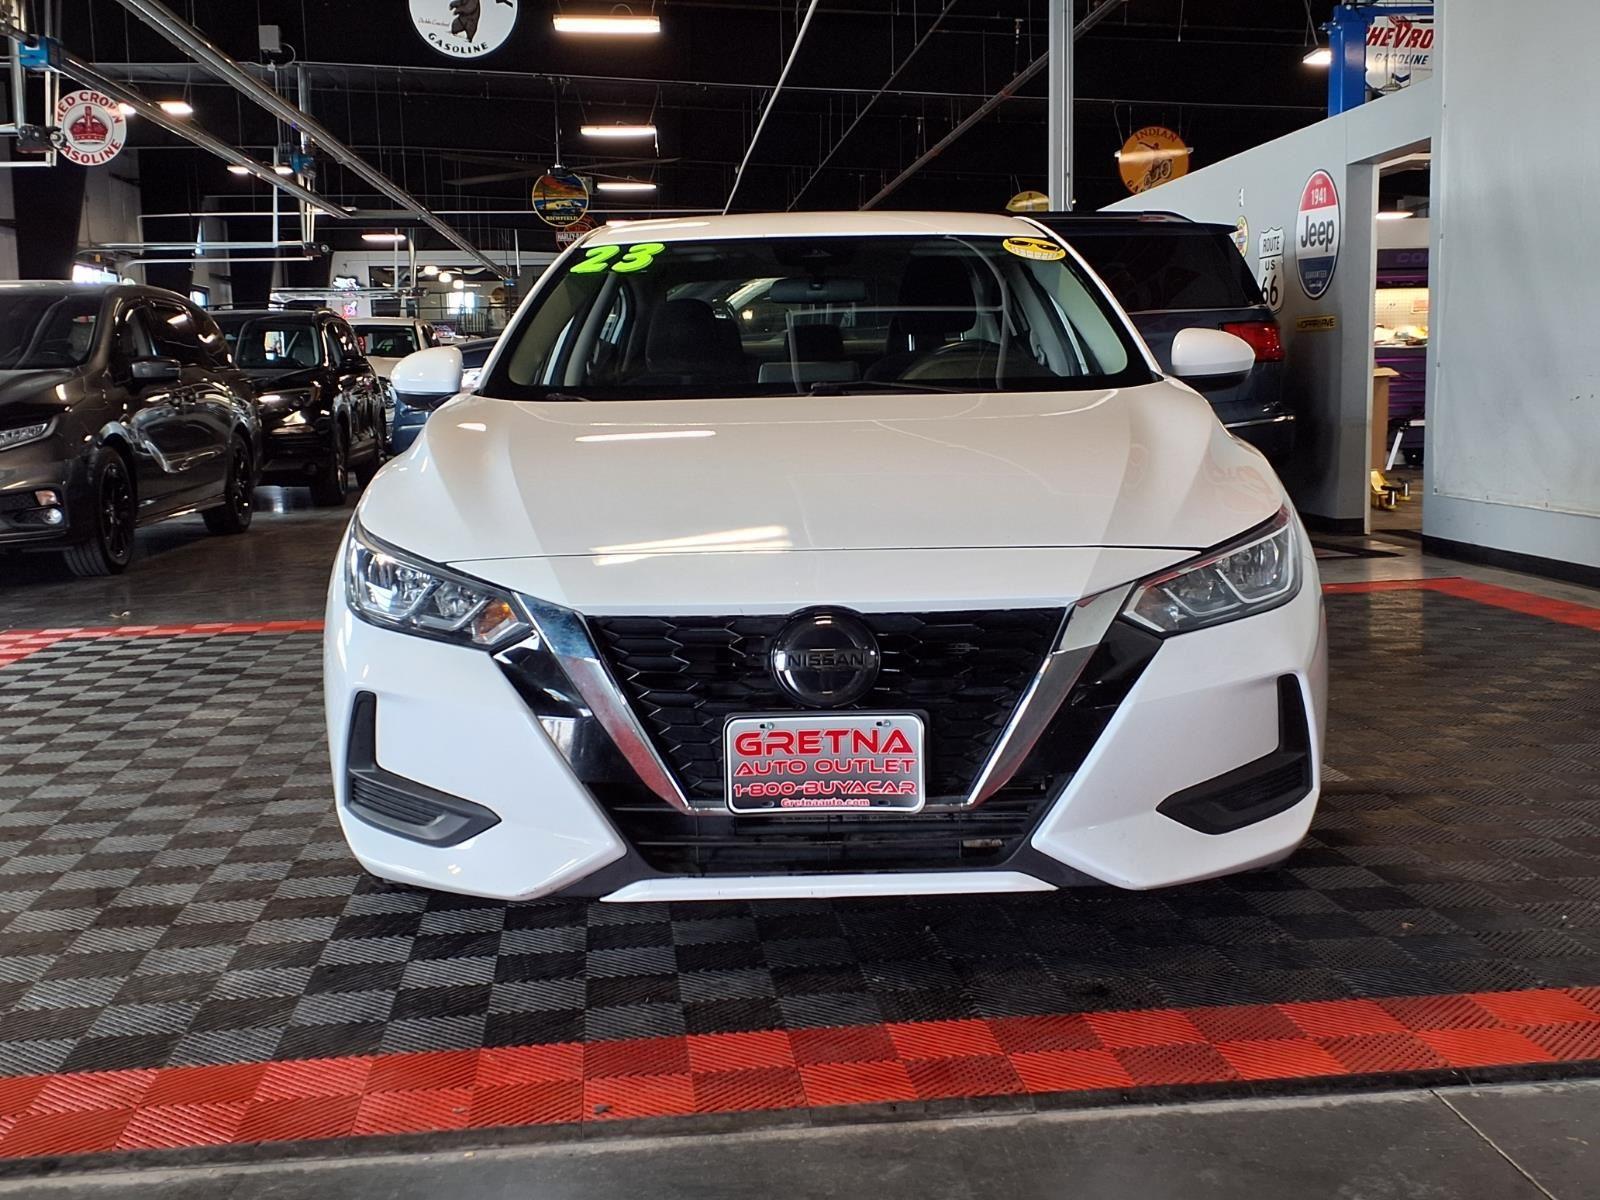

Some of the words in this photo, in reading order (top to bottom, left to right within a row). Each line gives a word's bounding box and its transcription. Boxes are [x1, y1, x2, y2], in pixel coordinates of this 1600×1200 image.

[428, 33, 489, 54] GASOLINE
[1365, 24, 1434, 48] HEVRO
[1375, 53, 1429, 65] GASOLINE
[1134, 128, 1177, 142] INDIAN
[62, 139, 121, 164] ASOLINE
[1311, 187, 1327, 206] 1941
[1300, 215, 1335, 253] Jeep
[1263, 236, 1280, 253] ROUTE
[569, 242, 665, 273] 23
[1265, 259, 1276, 271] US
[1262, 275, 1279, 306] 66
[786, 651, 864, 670] NISSAN
[735, 729, 915, 756] GRETNA
[734, 760, 807, 776] AUTO
[814, 758, 916, 774] OUTLET
[733, 781, 917, 797] 1-800-BUYACAR
[781, 798, 870, 807] Gretnaauto.com
